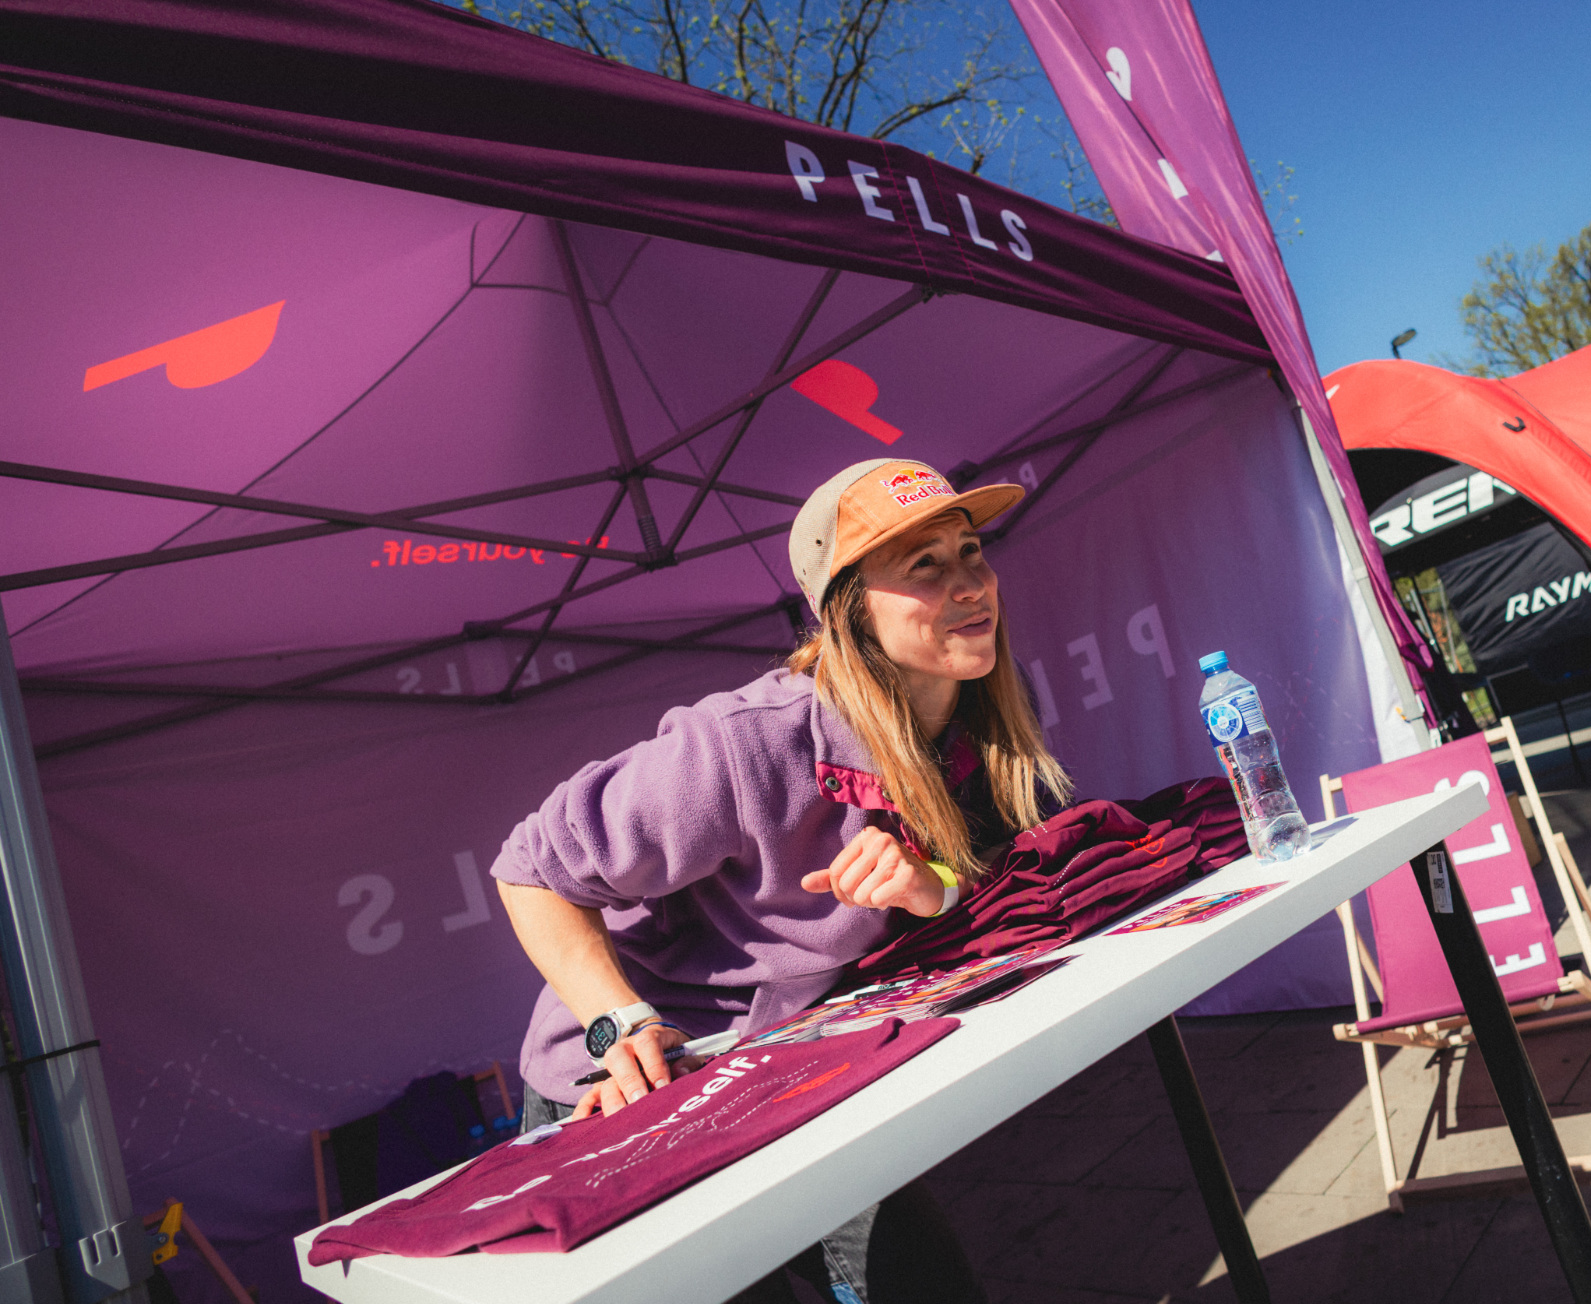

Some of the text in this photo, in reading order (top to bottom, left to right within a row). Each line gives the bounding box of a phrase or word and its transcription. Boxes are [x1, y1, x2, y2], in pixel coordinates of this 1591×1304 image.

[784, 140, 1033, 261] PELLS
[895, 484, 955, 506] Red Bull
[1369, 470, 1517, 547] REK
